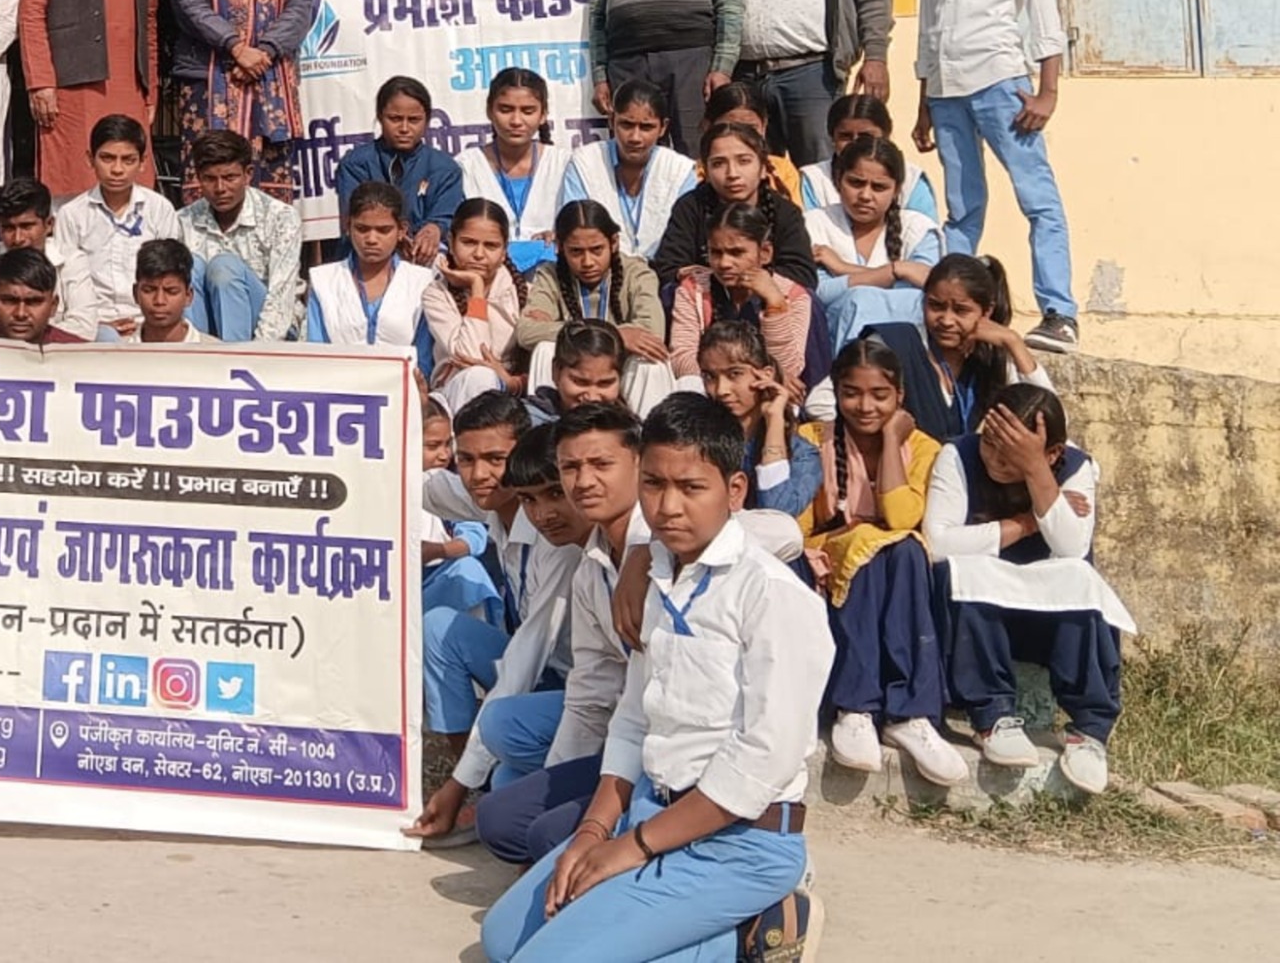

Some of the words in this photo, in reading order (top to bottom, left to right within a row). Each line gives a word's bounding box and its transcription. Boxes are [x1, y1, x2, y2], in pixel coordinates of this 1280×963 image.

[74, 368, 388, 460] फाउण्डेशन
[22, 465, 102, 489] सहयोग
[108, 465, 147, 490] करें
[178, 474, 236, 496] प्रभाव
[242, 474, 303, 499] बनाएँ
[248, 516, 393, 601] कार्यक्रम
[139, 600, 165, 642] में
[171, 606, 305, 659] सतर्कता)
[77, 748, 118, 774] नोएडा
